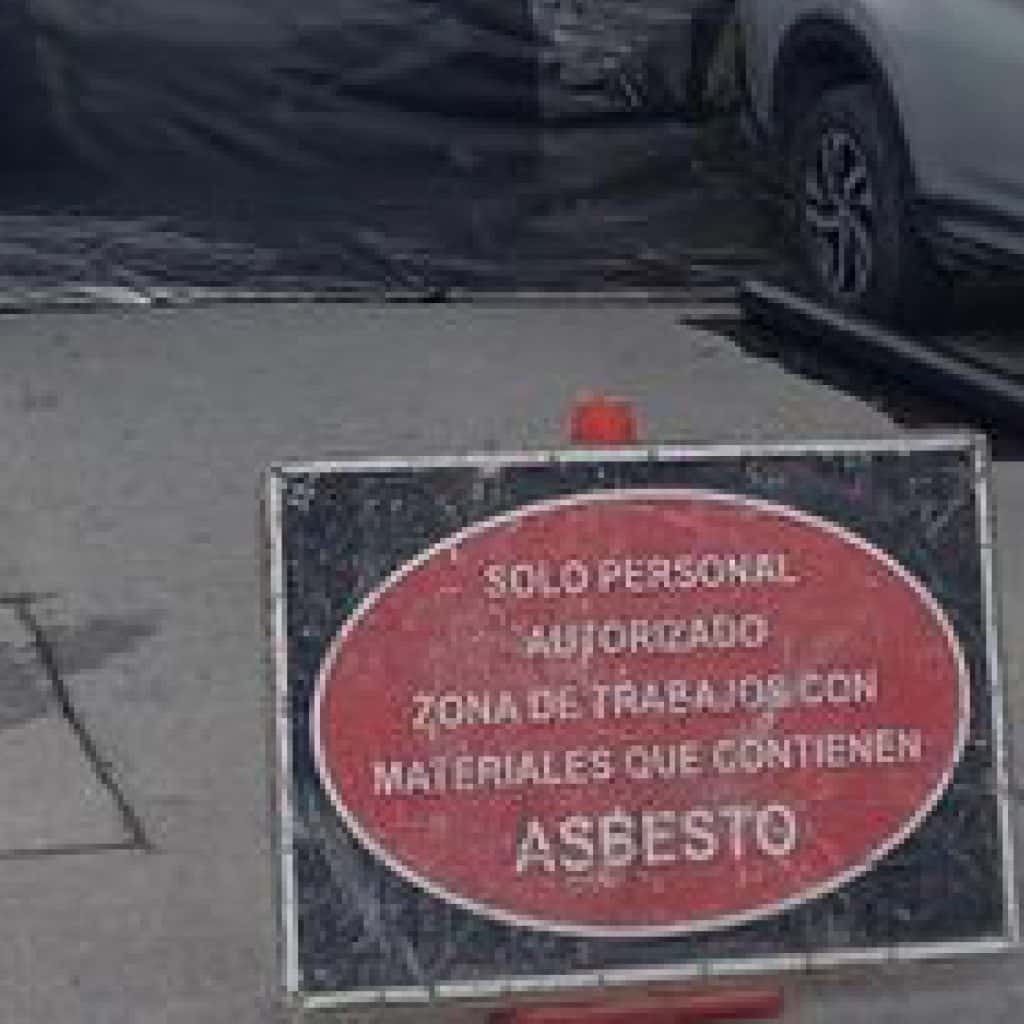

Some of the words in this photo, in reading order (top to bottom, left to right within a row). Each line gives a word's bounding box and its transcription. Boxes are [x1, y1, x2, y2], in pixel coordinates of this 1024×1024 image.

[483, 559, 588, 599] SOLO
[598, 553, 801, 594] PERSONAL
[522, 613, 769, 659] AUTORIZADO
[411, 692, 518, 731] ZONA
[527, 688, 579, 721] DE
[591, 674, 791, 720] TRABAJOS
[799, 669, 878, 707] CON
[373, 748, 612, 795] MATERIALES
[623, 742, 701, 782] QUE
[710, 727, 924, 773] CONTIENEN
[515, 804, 798, 873] ASBESTO
